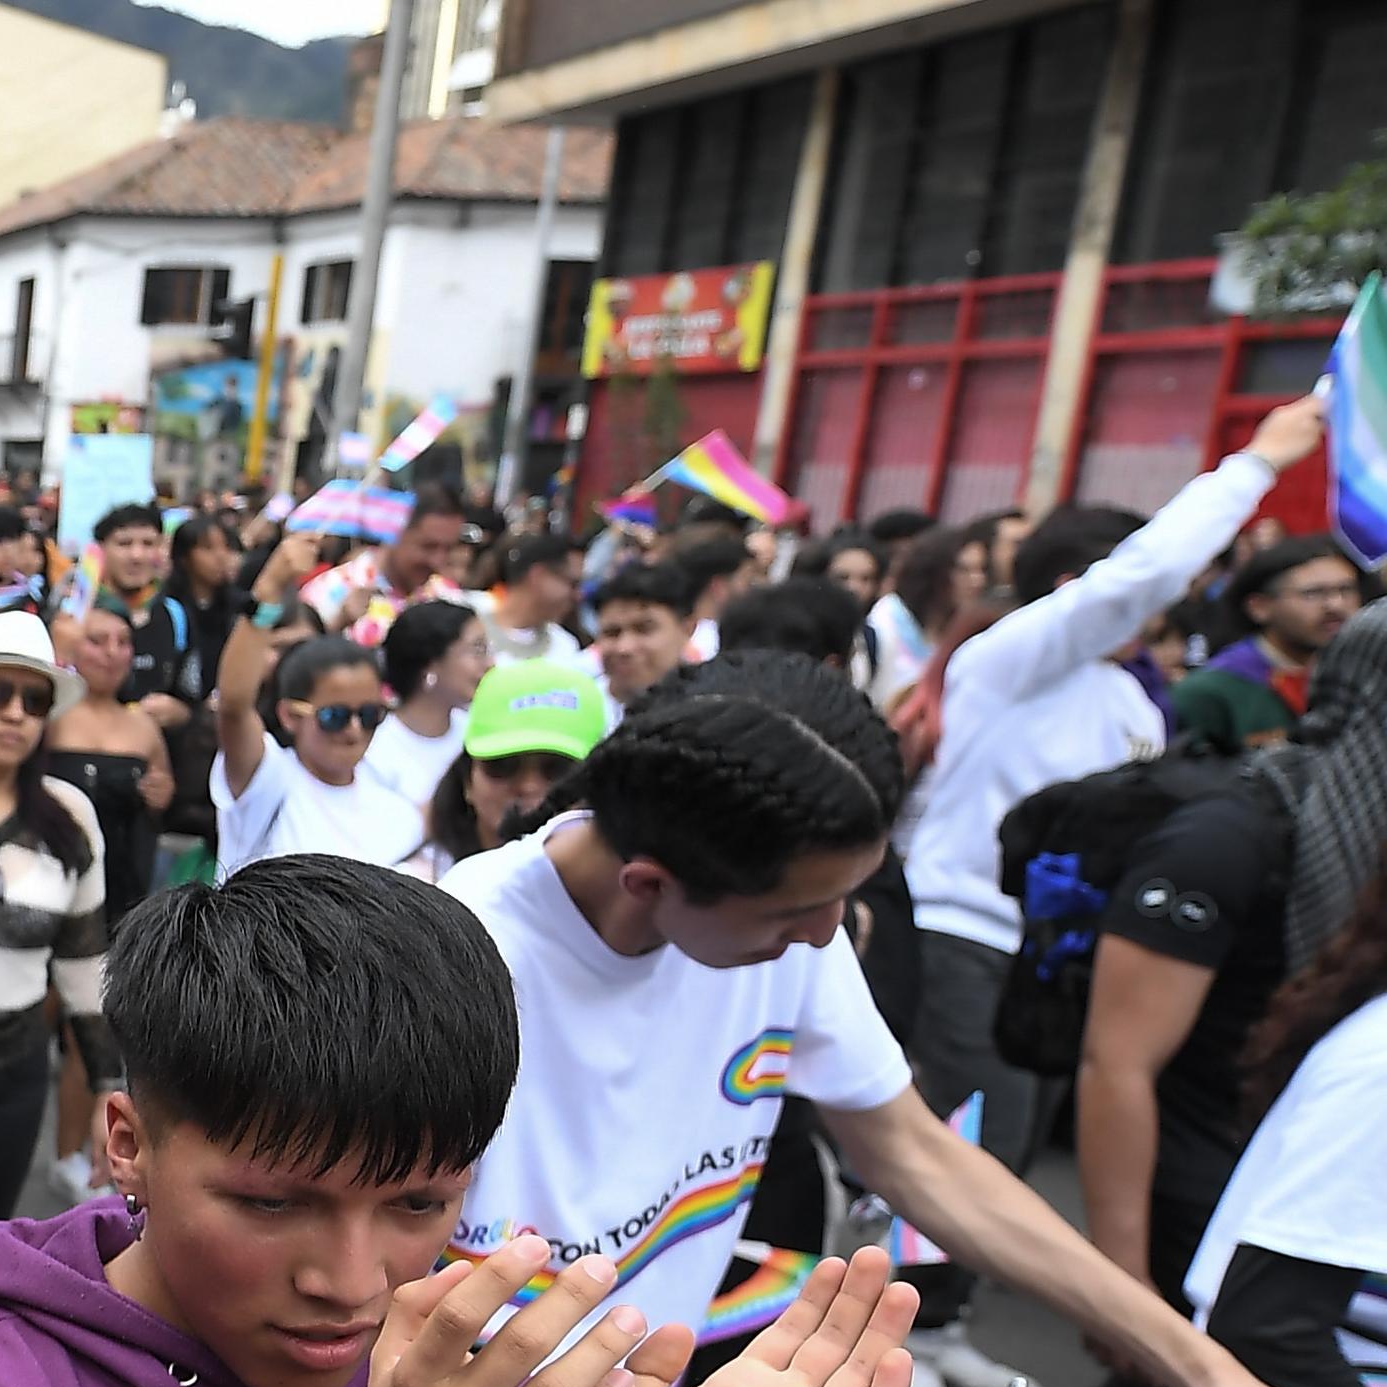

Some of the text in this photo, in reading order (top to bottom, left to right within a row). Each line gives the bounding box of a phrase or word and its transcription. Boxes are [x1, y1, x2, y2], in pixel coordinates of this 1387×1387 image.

[547, 1236, 602, 1264] CON
[606, 1180, 679, 1248] TODA
[684, 1145, 735, 1181] LAS
